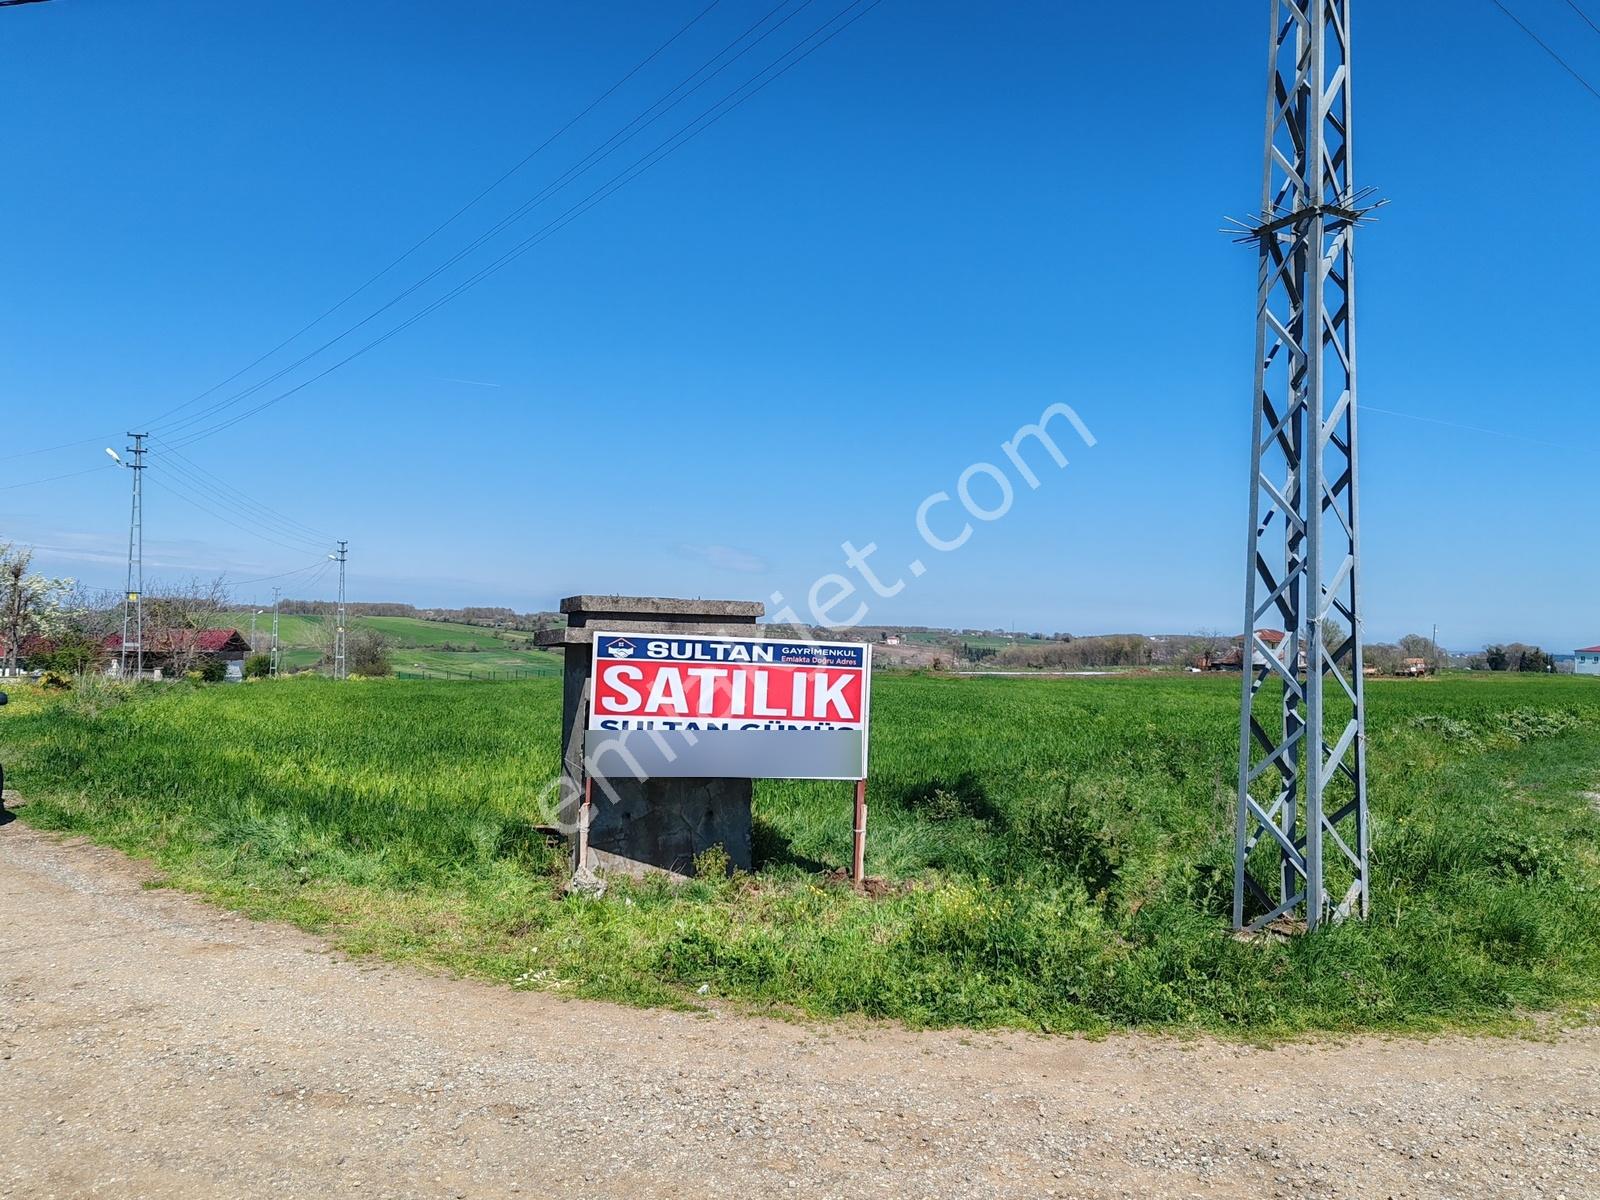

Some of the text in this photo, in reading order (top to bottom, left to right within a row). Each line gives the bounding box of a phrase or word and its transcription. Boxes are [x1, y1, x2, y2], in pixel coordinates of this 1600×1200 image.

[646, 640, 774, 662] SULTAN
[781, 655, 811, 664] Emlakta
[835, 658, 857, 666] Adres
[601, 664, 856, 719] SATILIK
